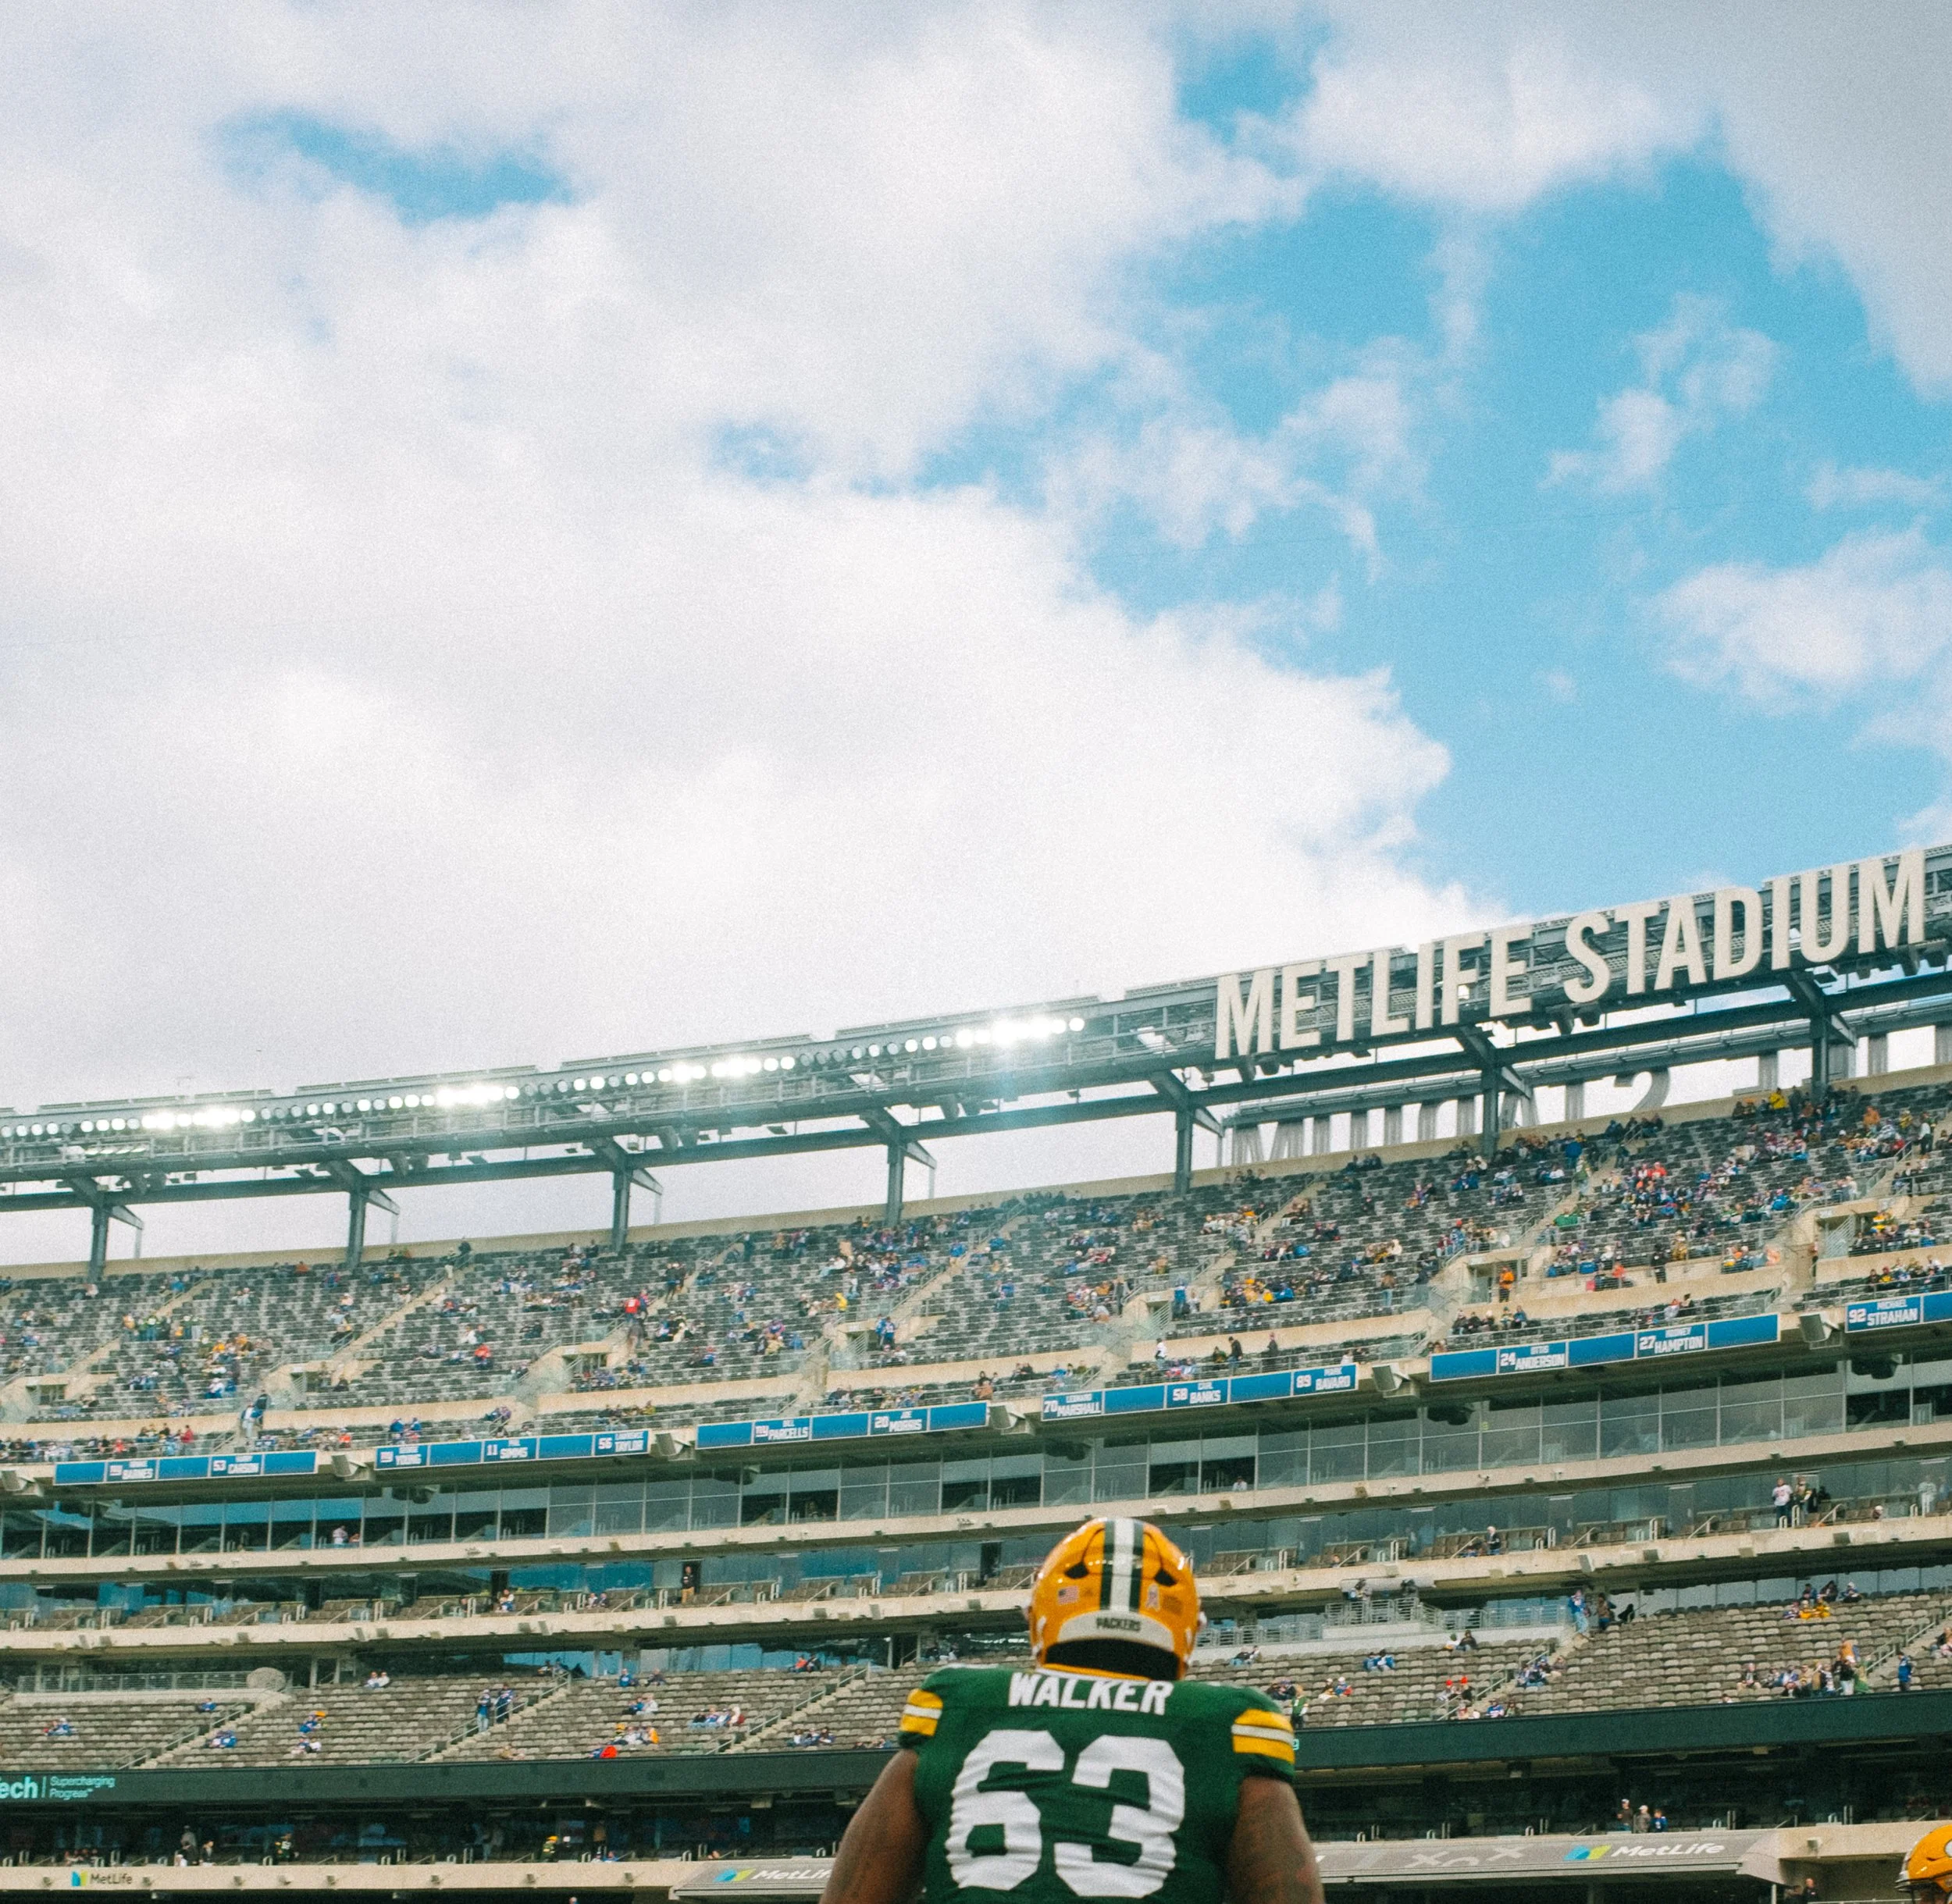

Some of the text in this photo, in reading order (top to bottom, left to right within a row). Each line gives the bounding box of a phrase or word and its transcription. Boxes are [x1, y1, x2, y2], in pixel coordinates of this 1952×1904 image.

[1214, 849, 1926, 1060] METLIFE STADIUM
[1849, 1308, 1918, 1326] 92 STRAHAN
[1639, 1335, 1704, 1354] 27 HAMPTON
[1500, 1352, 1565, 1370] 24 ANDERSON
[1296, 1375, 1351, 1390] 89 BAVARO
[1173, 1388, 1221, 1404] 58 BANKS
[1043, 1400, 1101, 1417] 70 MARSHALL
[874, 1416, 922, 1432] 20 MORRIS
[768, 1426, 809, 1440] PARCELLS
[486, 1444, 528, 1459] 11 SIMMS
[598, 1437, 643, 1453] 56 TAYLOR
[1096, 1617, 1142, 1632] PACKERS
[1008, 1672, 1174, 1715] WALKER
[0, 1776, 38, 1799] ech
[50, 1776, 116, 1788] Supercharging
[945, 1729, 1185, 1897] 63
[1611, 1843, 1725, 1857] MetLife
[91, 1873, 133, 1885] MetLife
